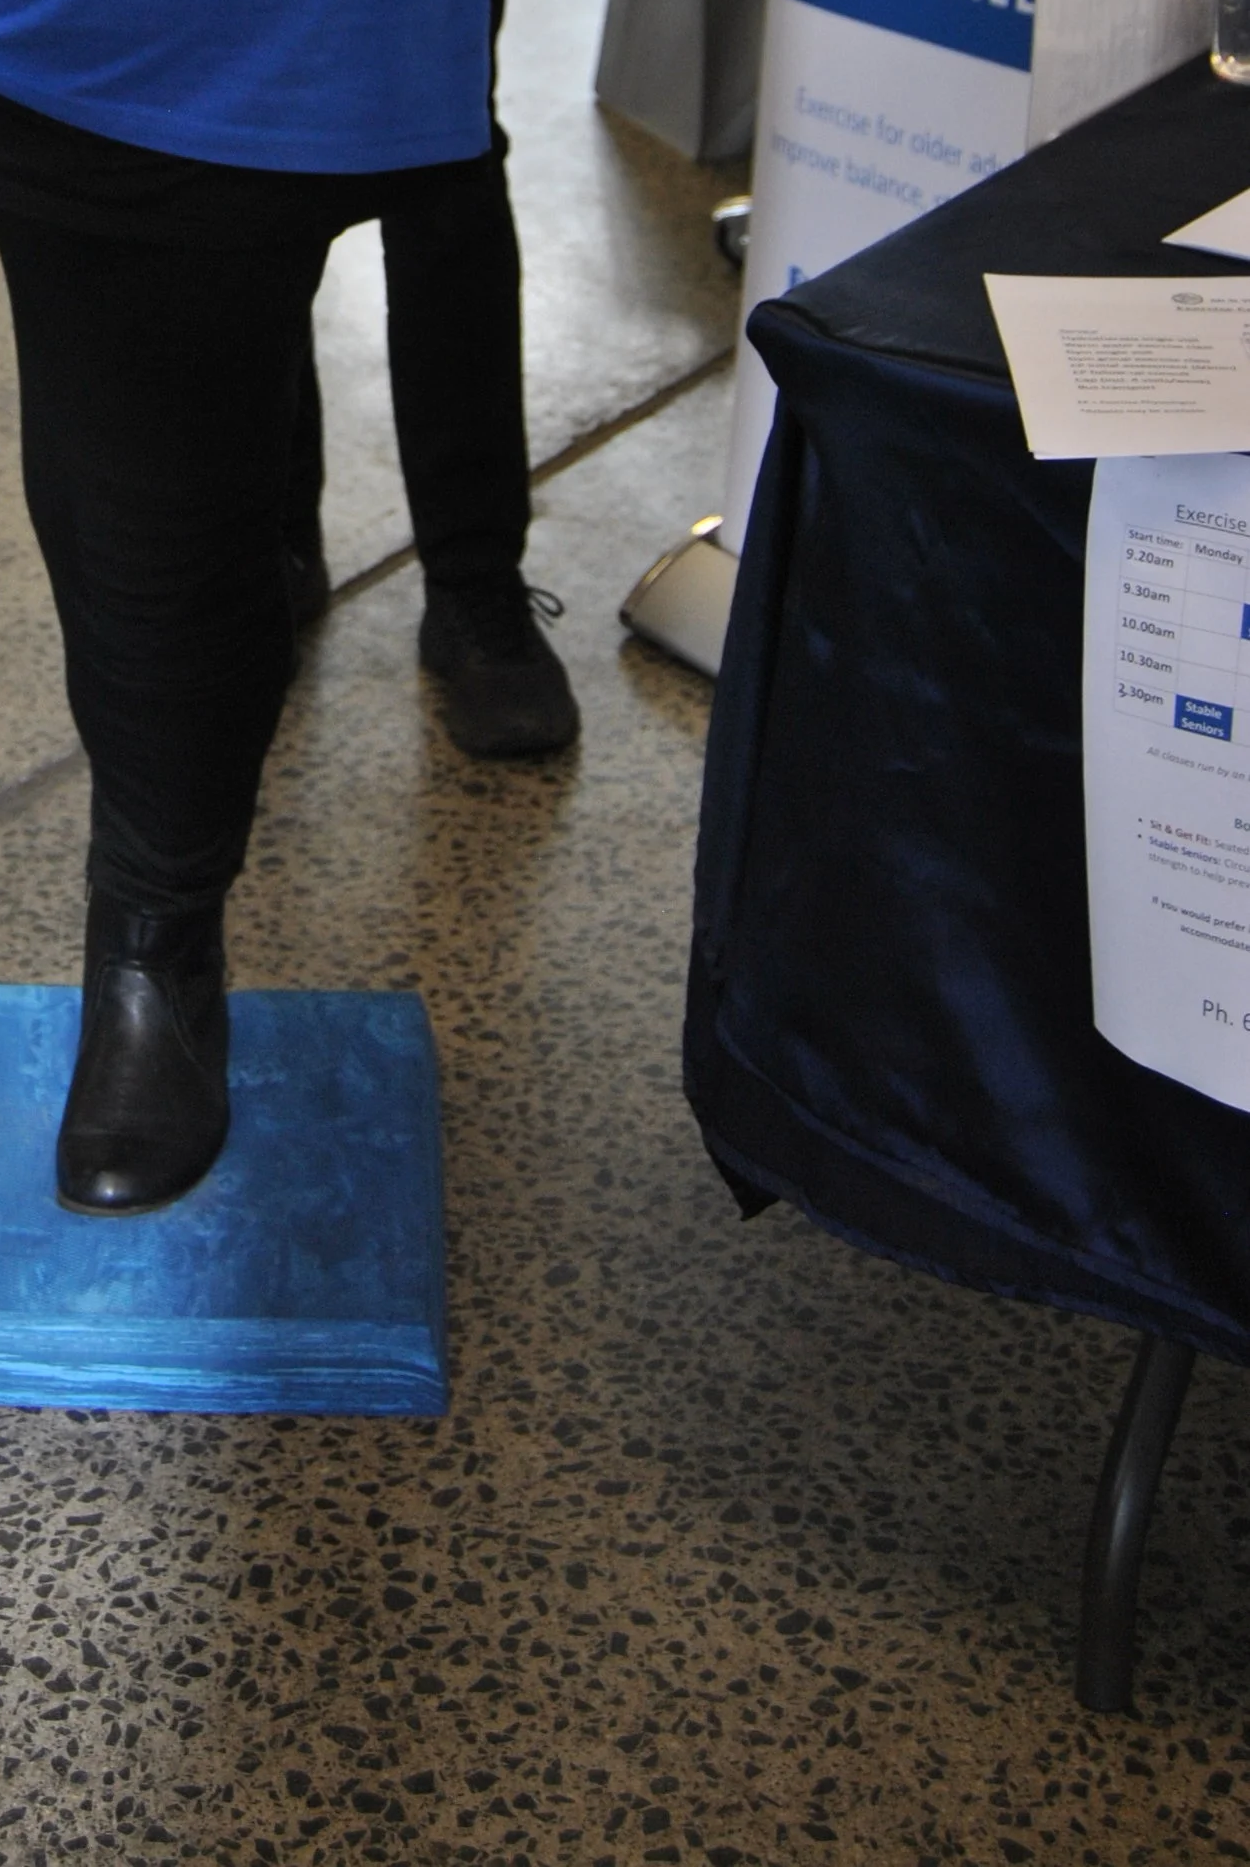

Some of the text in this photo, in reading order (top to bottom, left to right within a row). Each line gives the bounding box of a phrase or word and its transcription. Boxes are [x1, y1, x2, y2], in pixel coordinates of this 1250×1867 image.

[796, 85, 871, 135] Exercise
[875, 112, 904, 144] for
[910, 130, 962, 166] older
[1176, 503, 1247, 532] Exercise
[1128, 528, 1184, 550] Start time:
[1125, 547, 1174, 569] 9.20am
[1195, 543, 1244, 566] Monday
[1123, 582, 1171, 604] 9.30am
[1121, 616, 1175, 639] 10.00am
[1119, 650, 1173, 674] 10.30am
[1185, 700, 1223, 720] Stable
[1181, 716, 1225, 738] Seniors
[1164, 824, 1172, 834] &
[1175, 827, 1193, 842] Get
[1148, 835, 1179, 853] Stable
[1181, 846, 1221, 866] Seniors:
[1190, 865, 1201, 876] to
[1203, 869, 1226, 884] help
[1161, 900, 1179, 913] you
[1180, 908, 1211, 924] would
[1213, 918, 1246, 933] prefer
[1203, 999, 1234, 1027] Ph.
